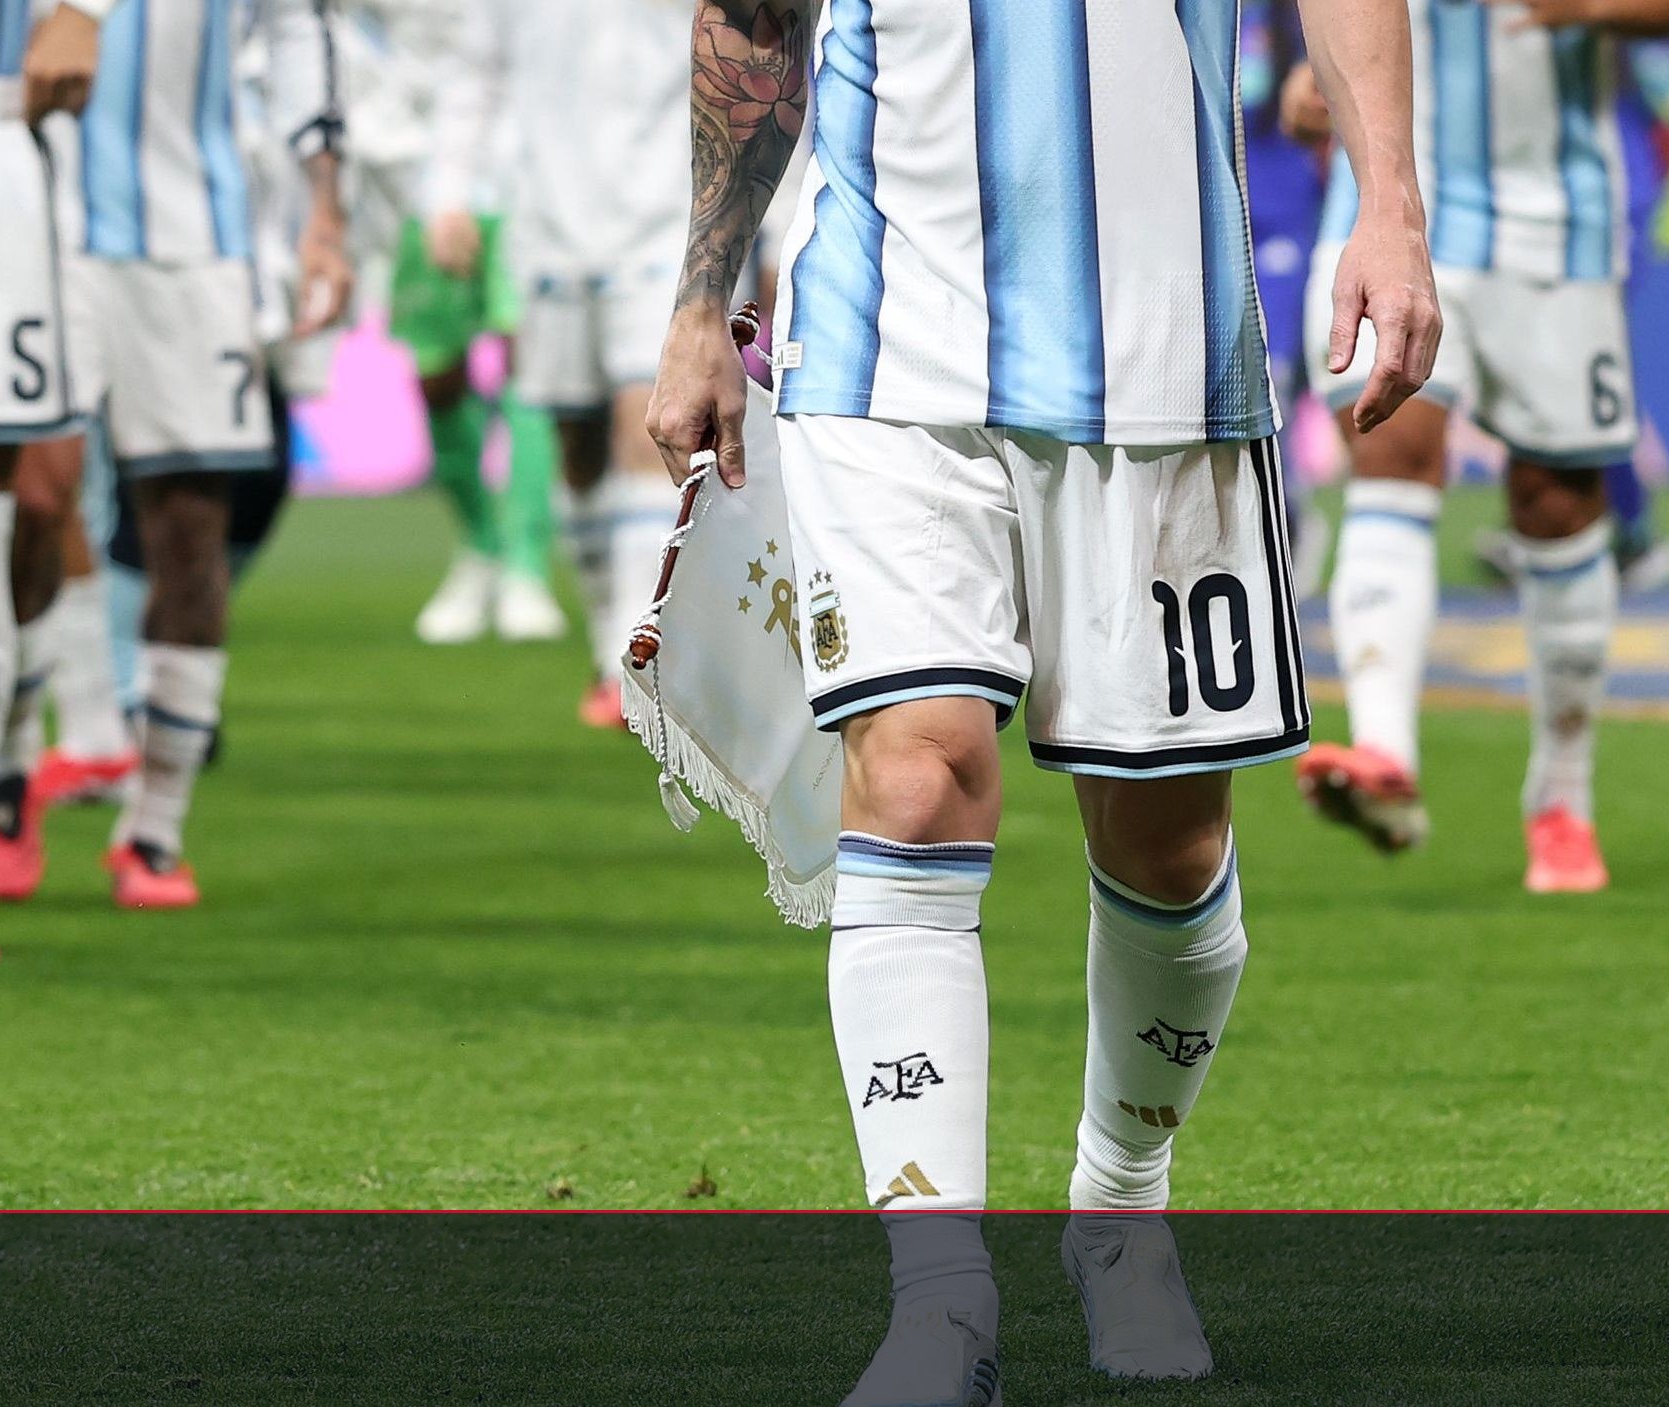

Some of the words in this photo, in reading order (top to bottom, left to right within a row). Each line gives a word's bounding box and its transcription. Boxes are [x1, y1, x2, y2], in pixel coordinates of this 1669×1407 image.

[218, 350, 255, 425] 7
[1589, 353, 1622, 427] 6
[1150, 573, 1255, 717] 10
[862, 1052, 944, 1108] AFA
[1136, 1018, 1214, 1068] AFA
